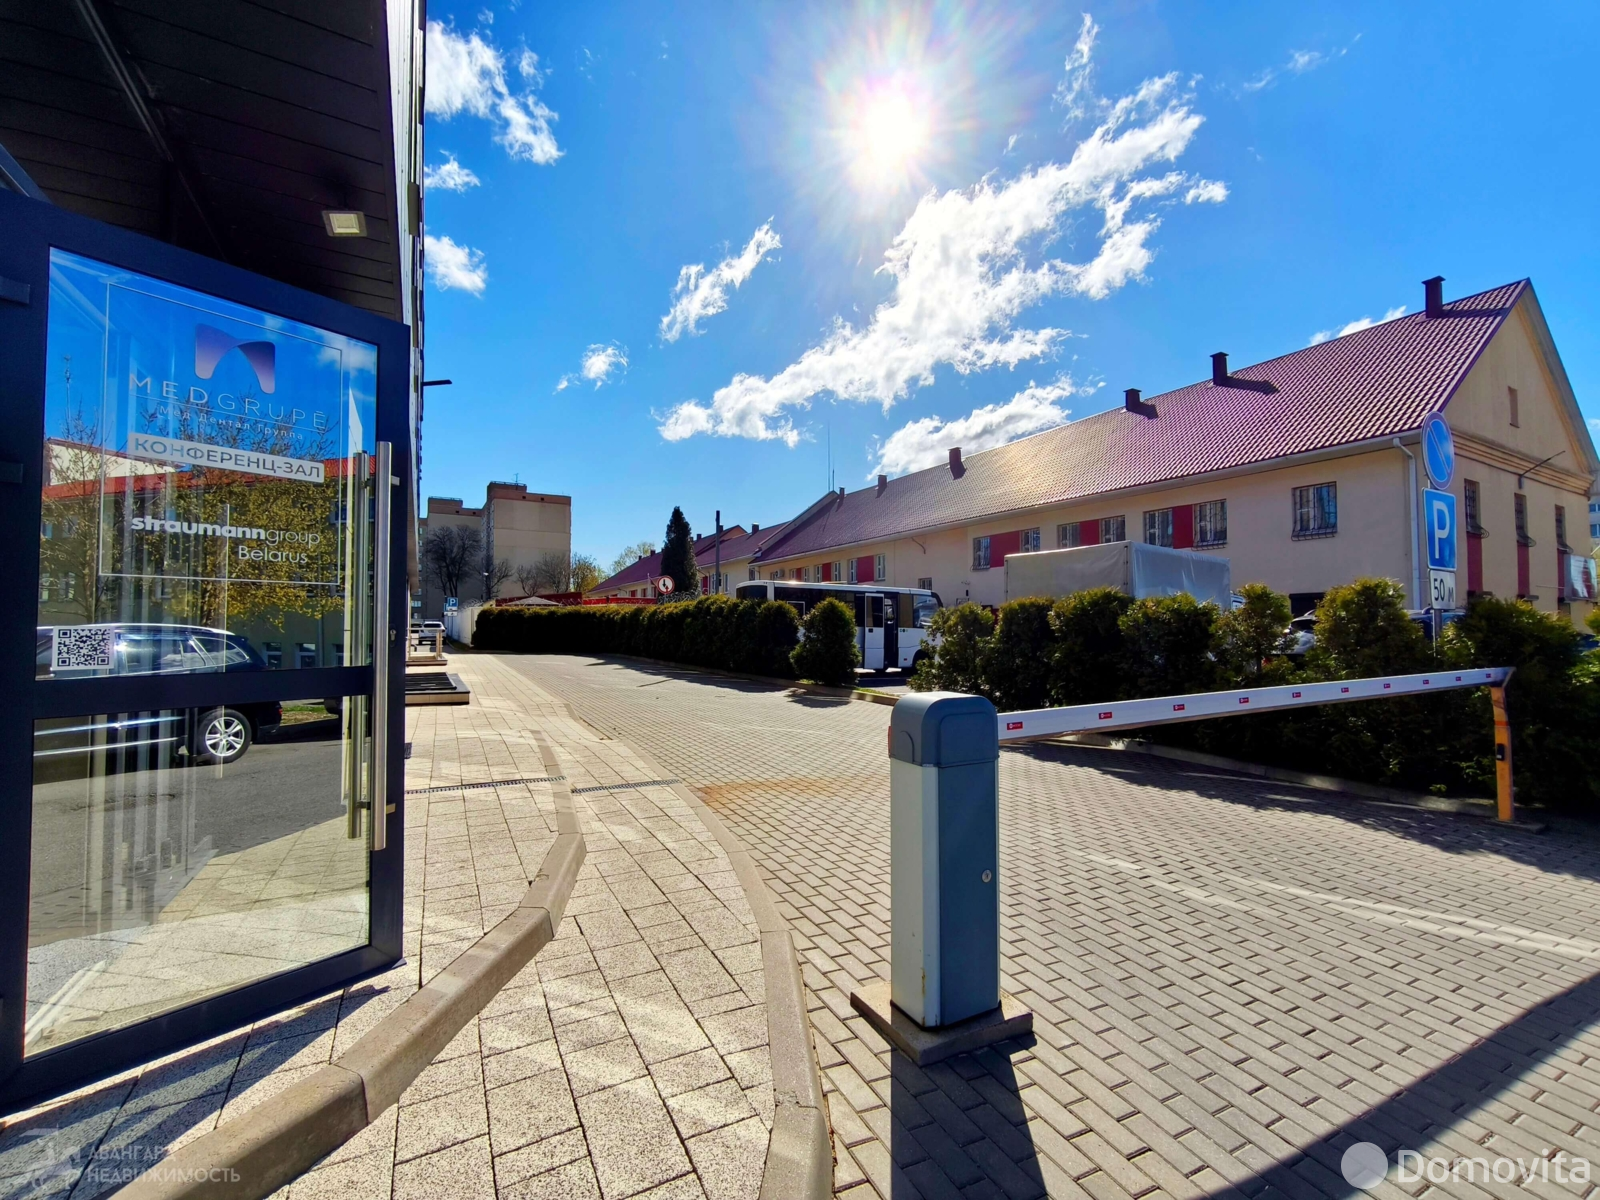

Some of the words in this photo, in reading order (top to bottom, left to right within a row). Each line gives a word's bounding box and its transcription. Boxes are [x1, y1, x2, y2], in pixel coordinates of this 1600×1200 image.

[160, 405, 191, 420] Мед
[199, 413, 250, 430] Дентал
[257, 424, 304, 440] Группа
[134, 437, 321, 479] КОНФЕРЕНЦ-ЗАЛ
[131, 515, 321, 549] straumanngroup
[1433, 500, 1450, 559] P
[238, 545, 308, 564] Belarus
[1433, 578, 1445, 602] 50
